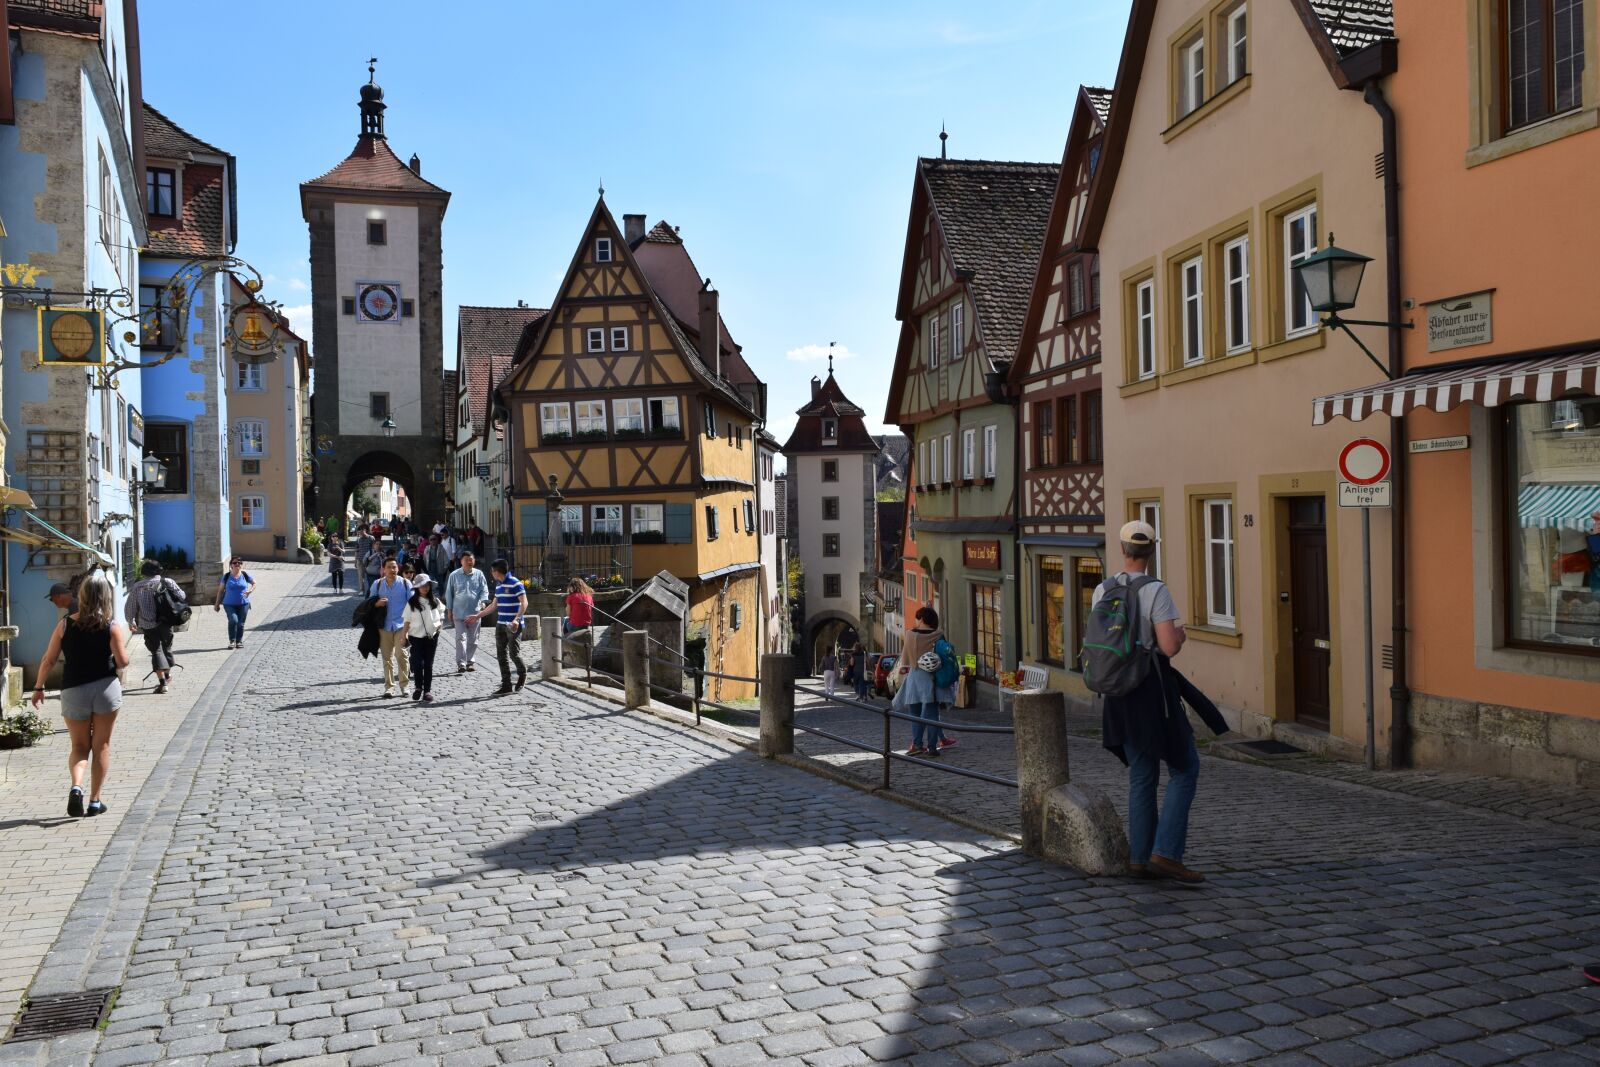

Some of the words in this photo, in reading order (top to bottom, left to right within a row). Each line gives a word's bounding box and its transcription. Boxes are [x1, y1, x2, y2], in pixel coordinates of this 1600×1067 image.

[1429, 314, 1461, 328] Abfahrt
[1463, 312, 1479, 322] nur
[1345, 485, 1384, 496] Anlieger
[1357, 495, 1373, 503] frei
[1243, 514, 1254, 528] 28
